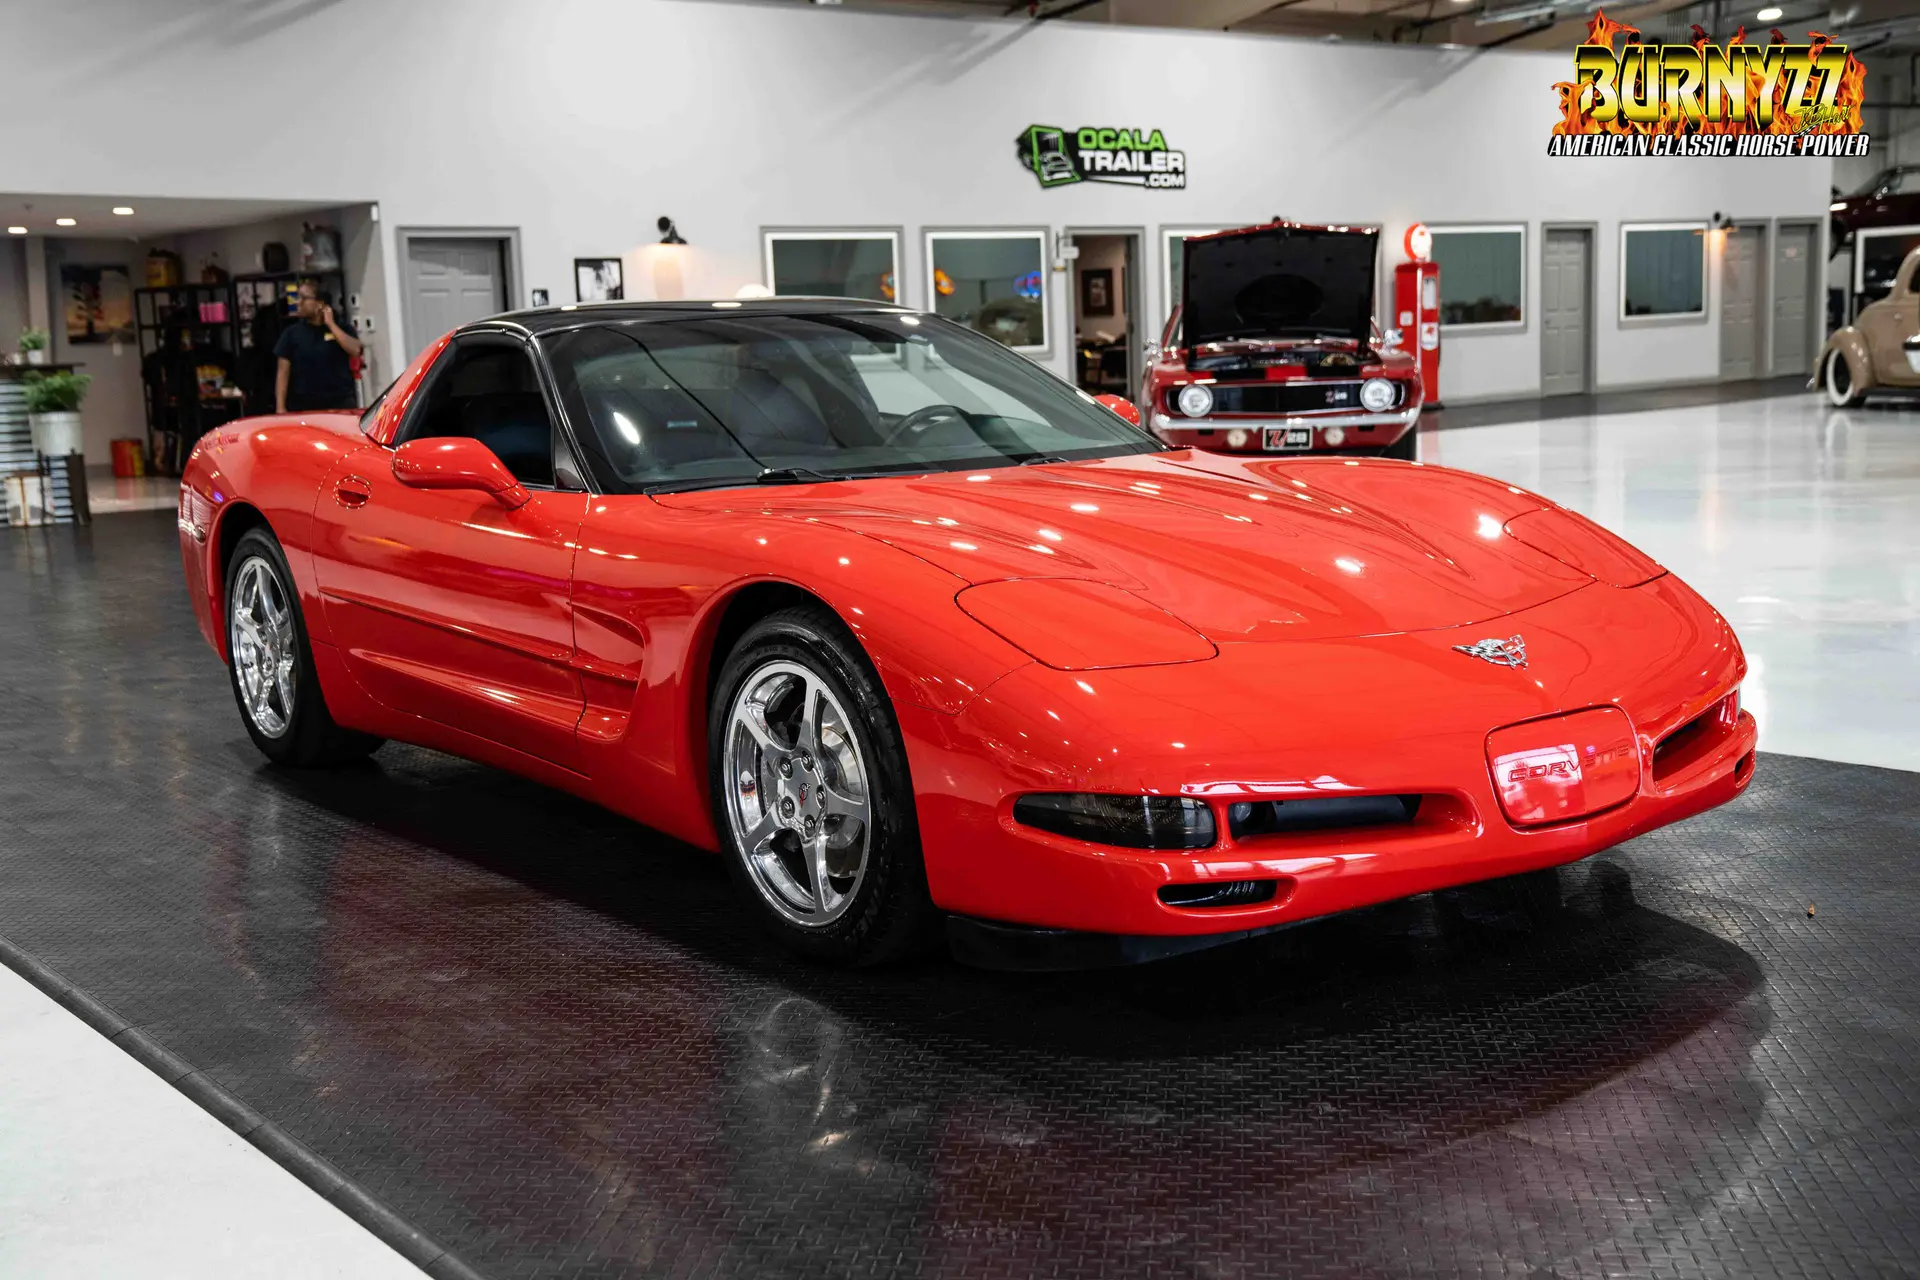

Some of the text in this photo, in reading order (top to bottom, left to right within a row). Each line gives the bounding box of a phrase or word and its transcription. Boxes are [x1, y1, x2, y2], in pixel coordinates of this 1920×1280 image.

[1077, 128, 1166, 150] OCALA
[1078, 151, 1184, 172] TRAILER
[1145, 173, 1185, 187] .COM
[1508, 743, 1630, 783] CORVETTE
